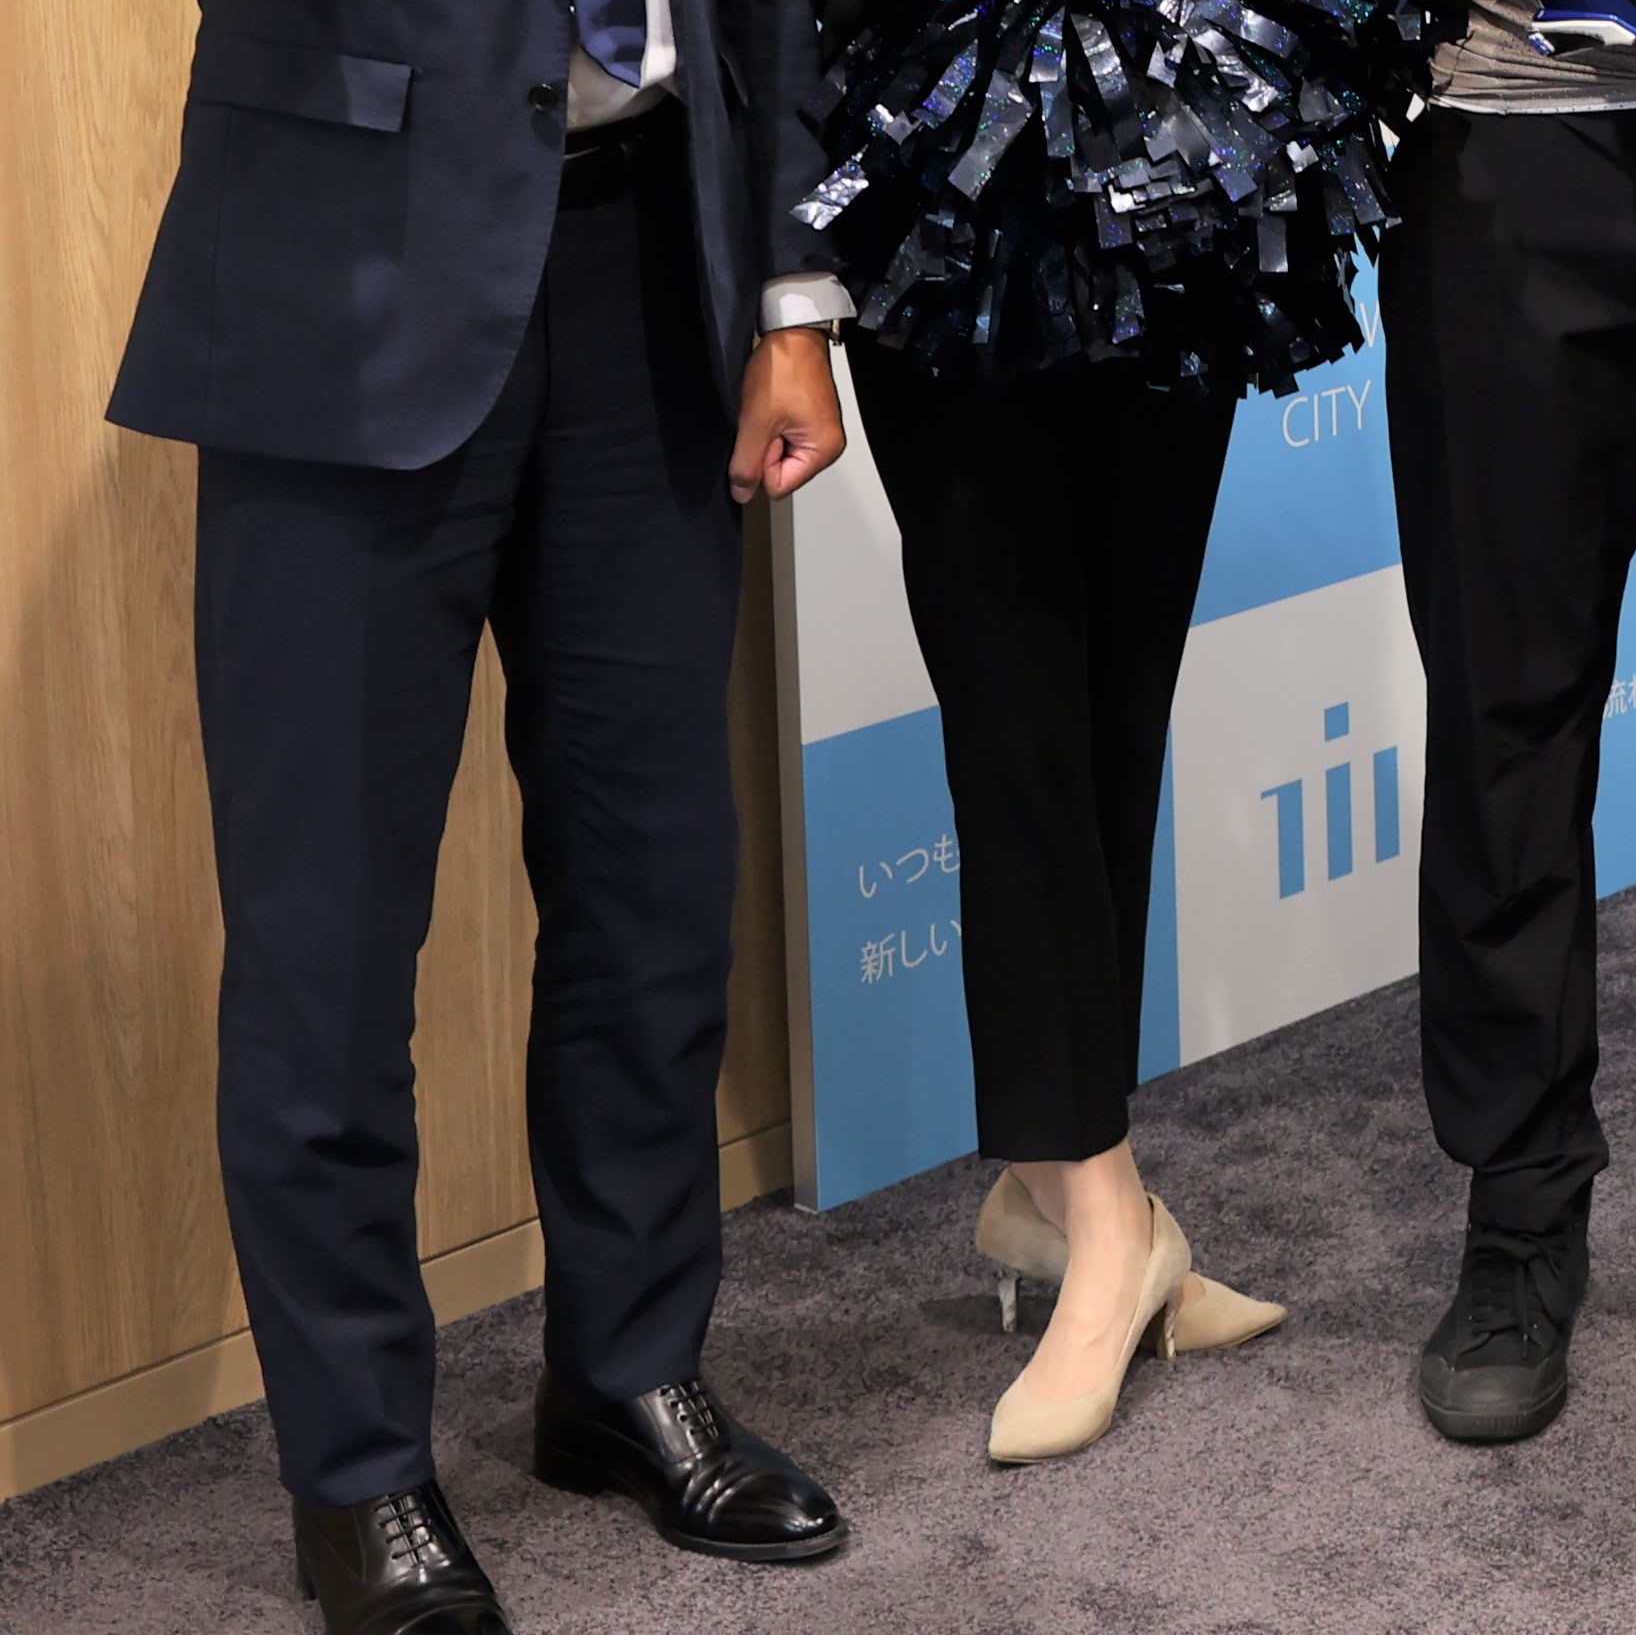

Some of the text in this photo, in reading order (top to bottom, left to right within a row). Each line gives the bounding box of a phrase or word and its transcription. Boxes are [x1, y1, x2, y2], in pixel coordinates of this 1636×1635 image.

[1282, 378, 1373, 448] CITY
[858, 833, 961, 899] いつも
